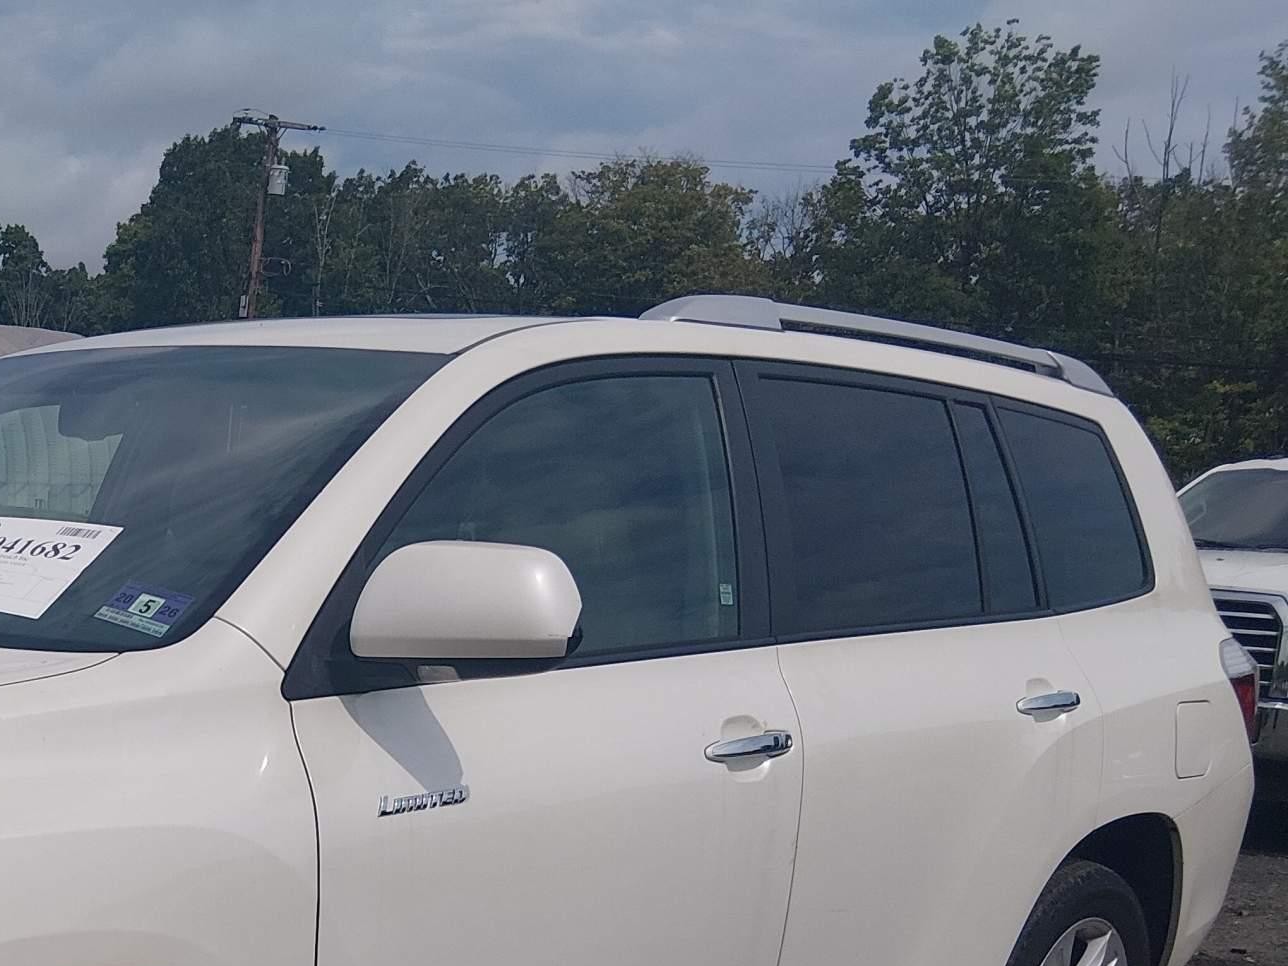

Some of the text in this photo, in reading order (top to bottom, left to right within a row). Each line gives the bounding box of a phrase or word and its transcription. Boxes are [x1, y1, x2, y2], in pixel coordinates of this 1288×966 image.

[114, 592, 180, 618] 20 5 26
